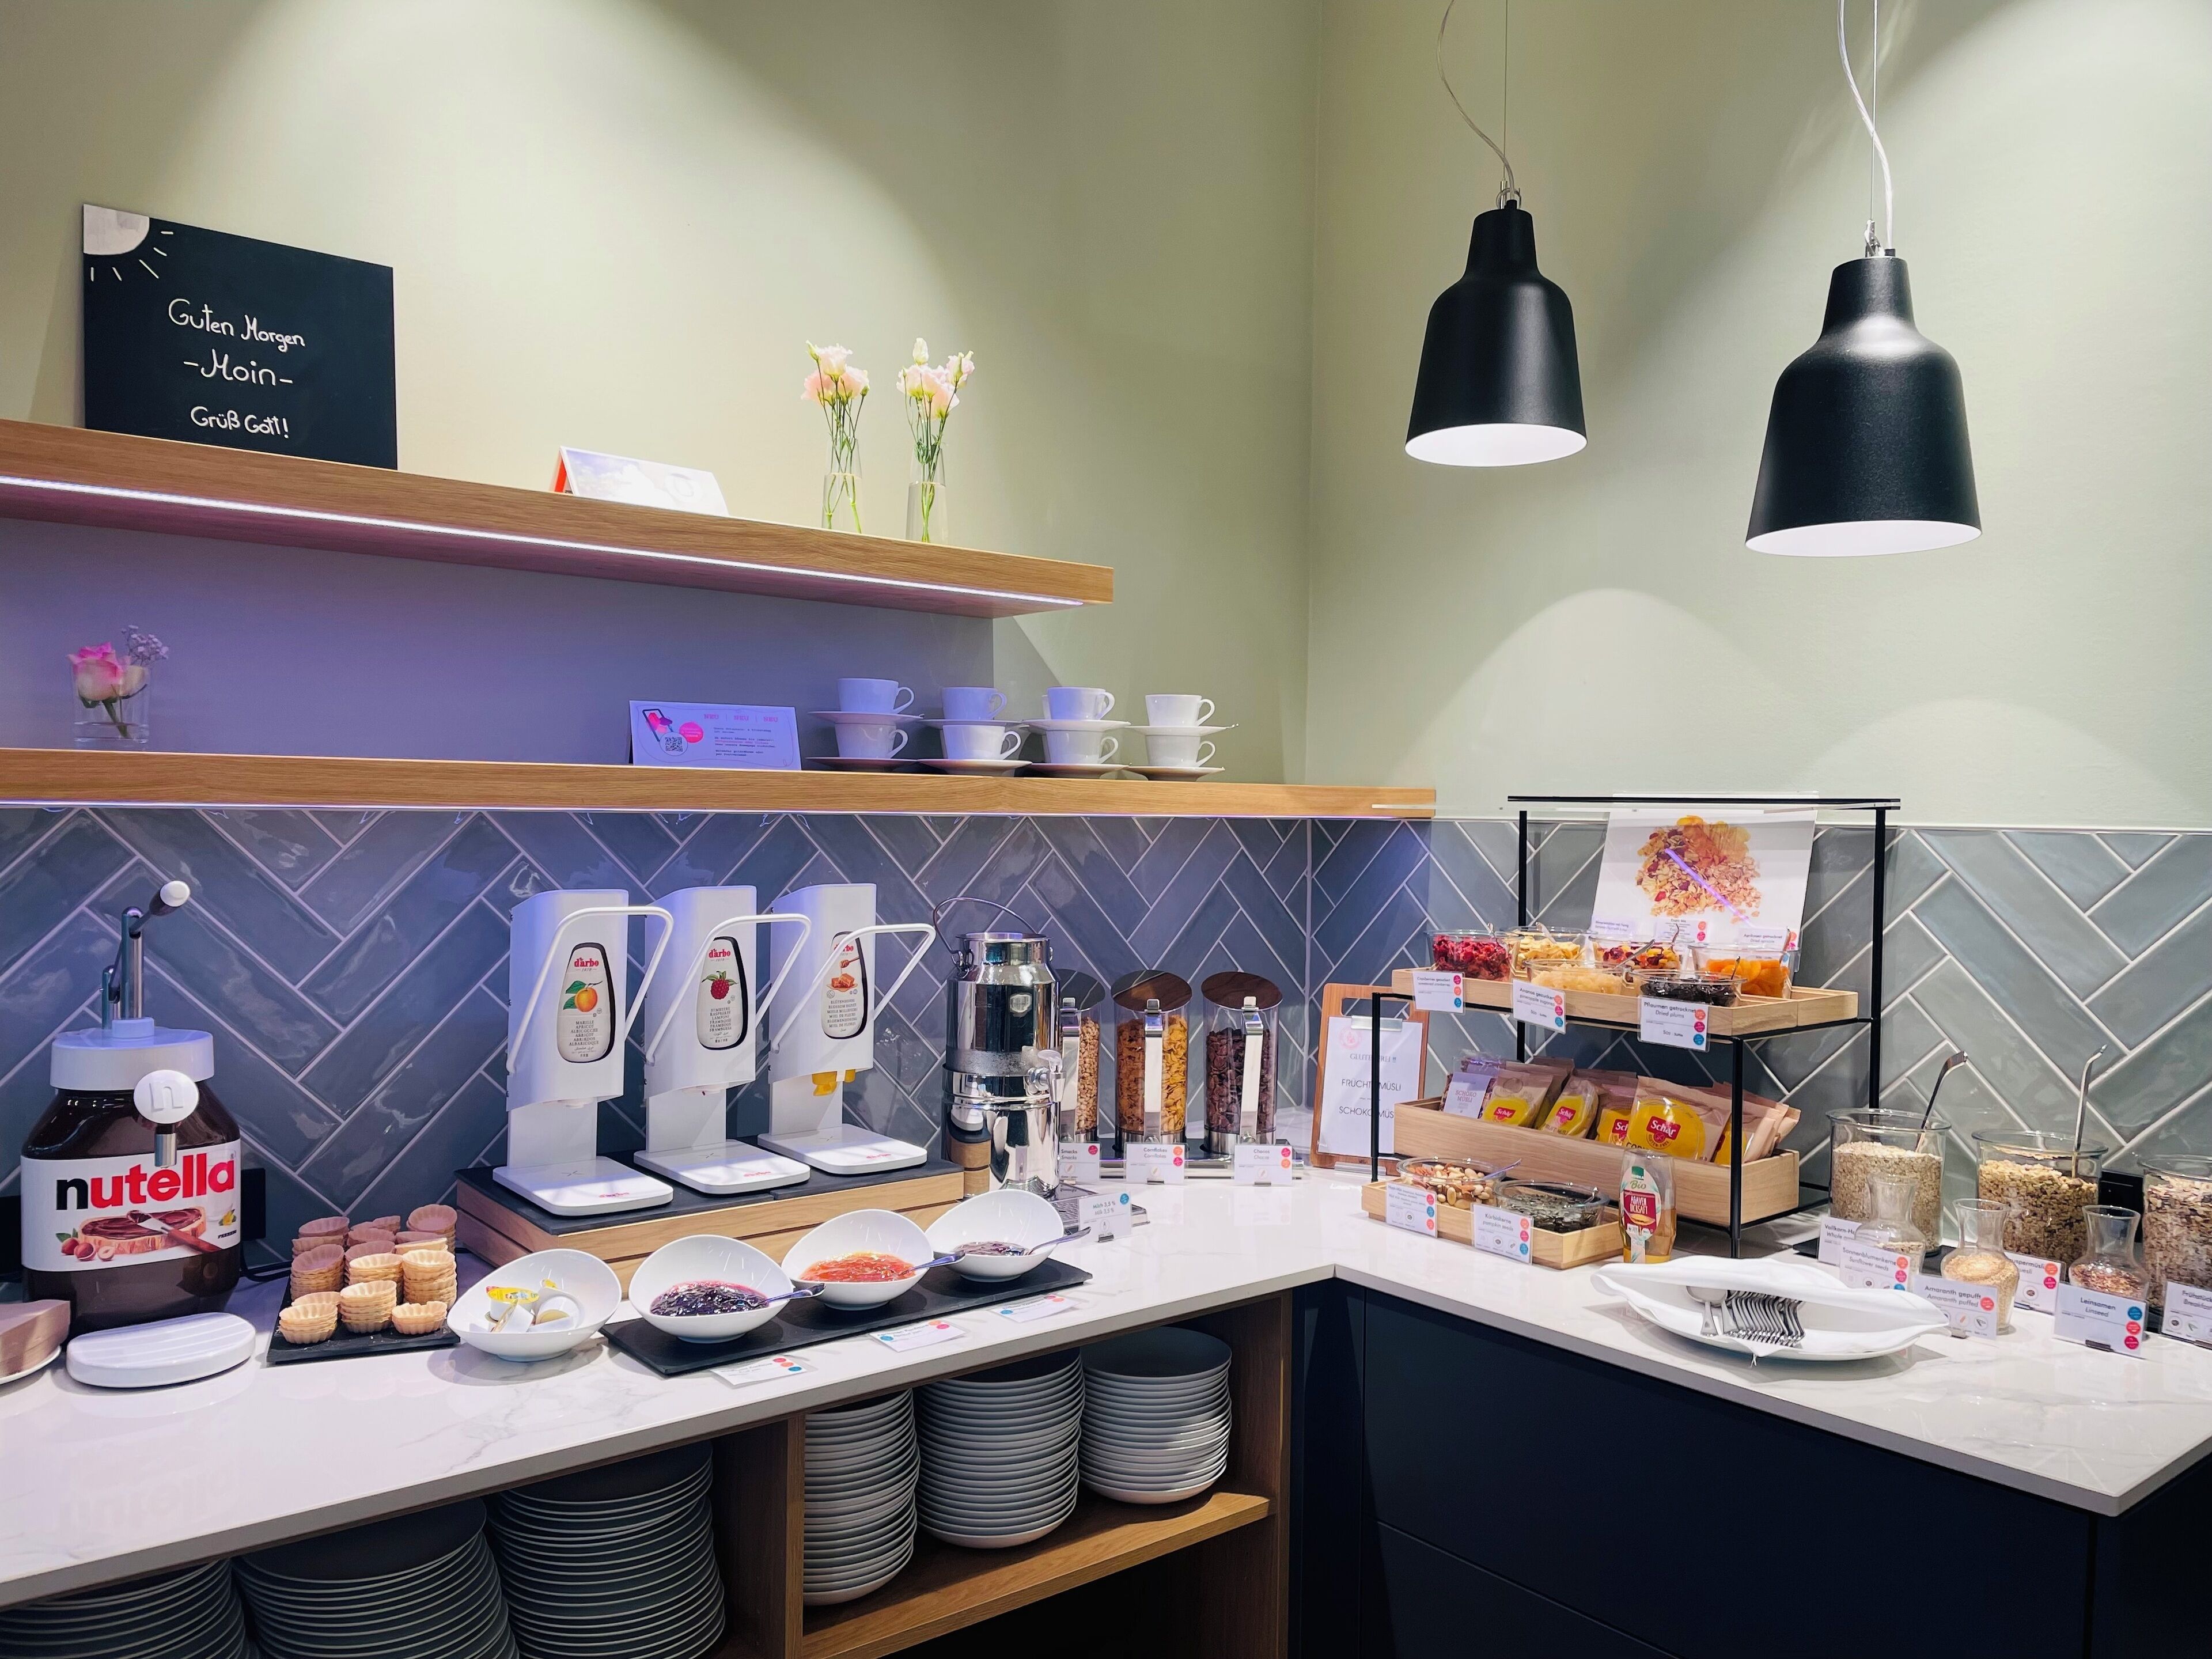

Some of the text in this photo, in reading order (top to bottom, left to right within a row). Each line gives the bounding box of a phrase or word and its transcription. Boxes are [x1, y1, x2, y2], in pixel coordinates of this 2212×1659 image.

[168, 298, 306, 353] Guten Morgen
[191, 406, 289, 439] Grüß Gott!
[1650, 1120, 1677, 1137] Schär
[55, 1153, 235, 1210] nutella
[1630, 1180, 1646, 1189] Bio
[1631, 1195, 1647, 1206] AGAVEN
[1630, 1205, 1647, 1214] DICKSAFT
[1485, 1214, 1512, 1224] Kürbiskerne
[1843, 1247, 1896, 1266] Sonnenblumenkerne
[1849, 1256, 1873, 1267] Sunflower
[1925, 1286, 1957, 1296] Amaranth
[1927, 1294, 1979, 1308] Amaranth puffed
[2080, 1297, 2116, 1310] Leinsamen
[2085, 1306, 2109, 1317] Linseed
